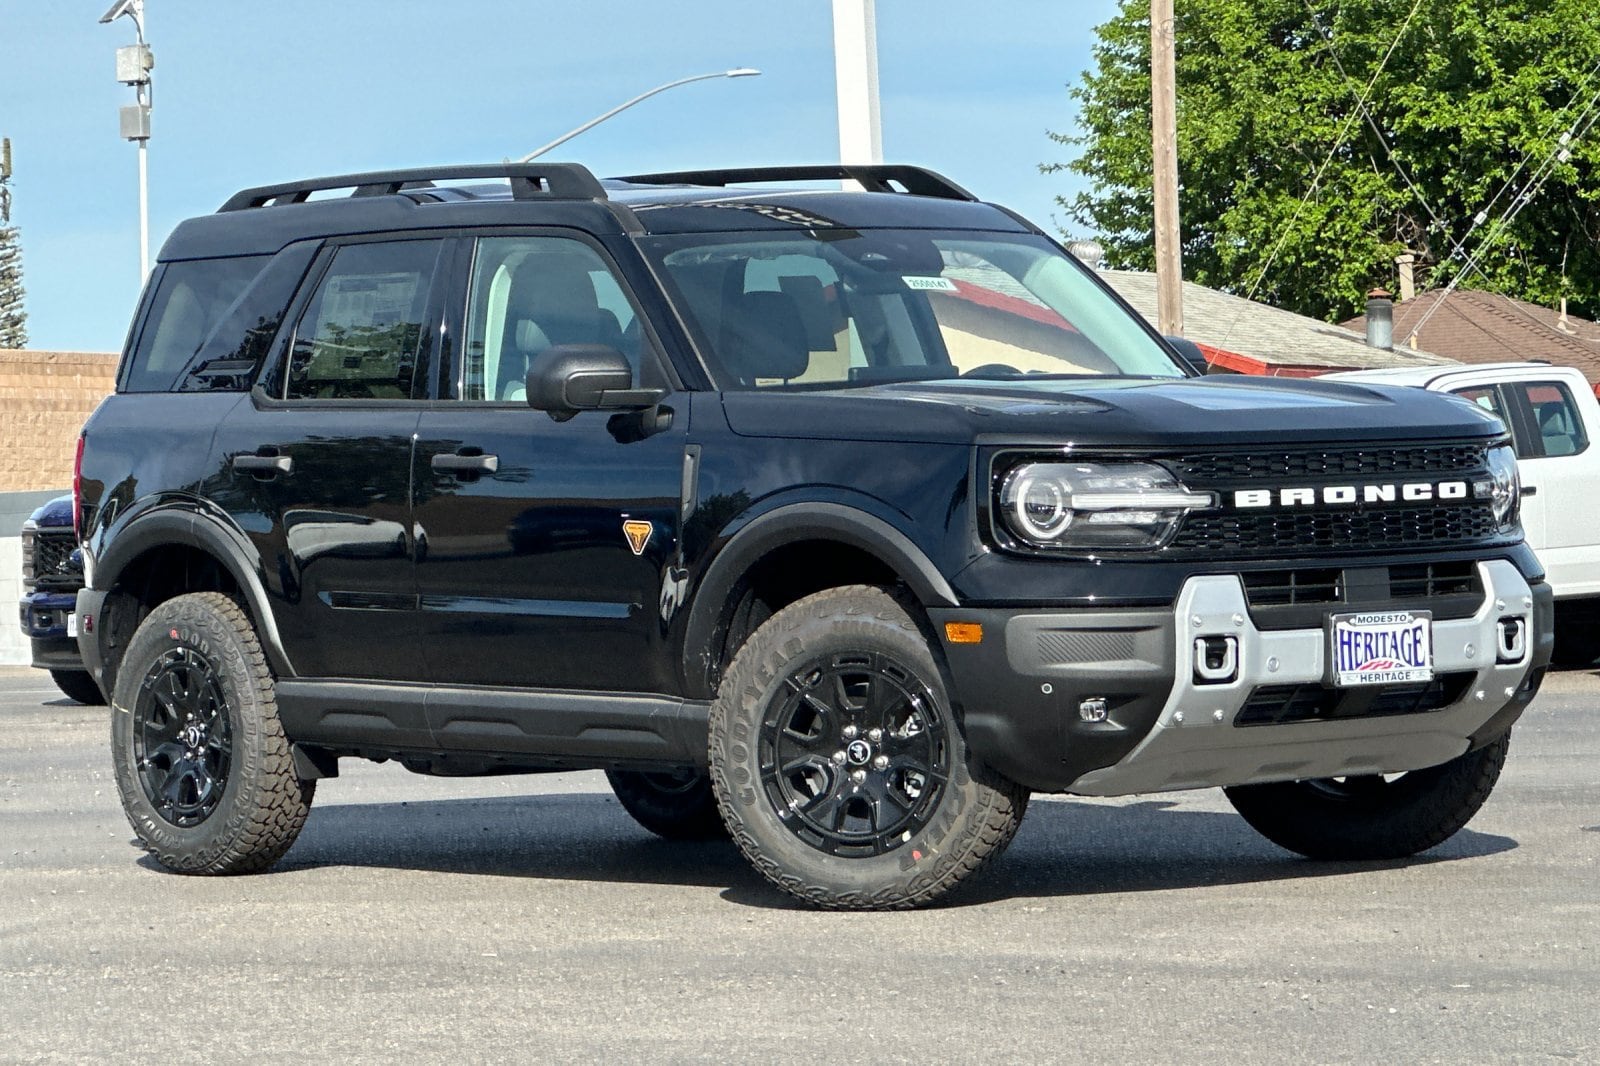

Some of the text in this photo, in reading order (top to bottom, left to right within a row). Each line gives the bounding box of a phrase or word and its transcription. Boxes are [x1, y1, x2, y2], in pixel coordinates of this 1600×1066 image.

[1235, 482, 1466, 508] BRONCO
[1357, 614, 1407, 624] MODESTO
[1339, 624, 1426, 671] HERITAGE
[1360, 671, 1411, 683] HERITAGE
